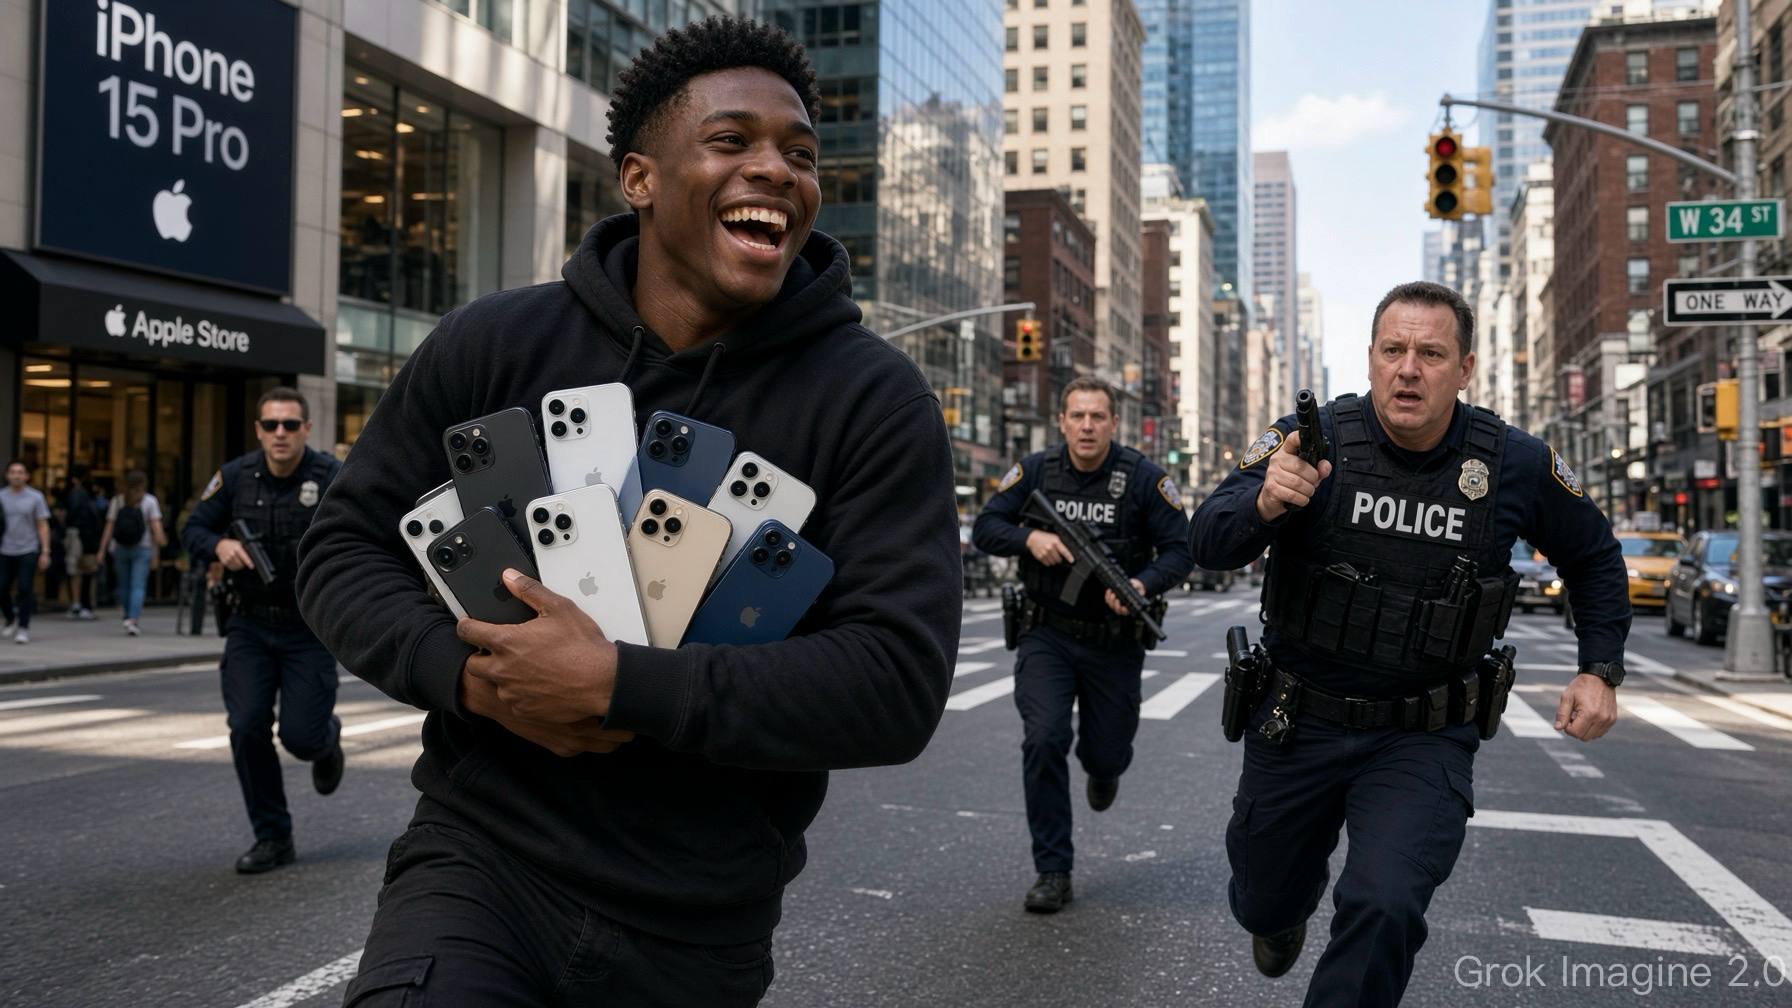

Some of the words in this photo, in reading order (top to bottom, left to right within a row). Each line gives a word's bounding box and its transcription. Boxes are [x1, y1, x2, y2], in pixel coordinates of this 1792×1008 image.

[96, 0, 255, 103] iPhone
[98, 74, 160, 148] 15
[172, 94, 250, 171] Pro
[1679, 207, 1701, 236] W
[1709, 206, 1744, 235] 34
[1751, 205, 1772, 224] ST
[1686, 294, 1725, 311] ONE
[1743, 291, 1786, 309] WAY
[131, 310, 195, 348] Apple
[197, 319, 250, 353] Store
[1055, 499, 1116, 524] POLICE
[1351, 490, 1467, 542] POLICE
